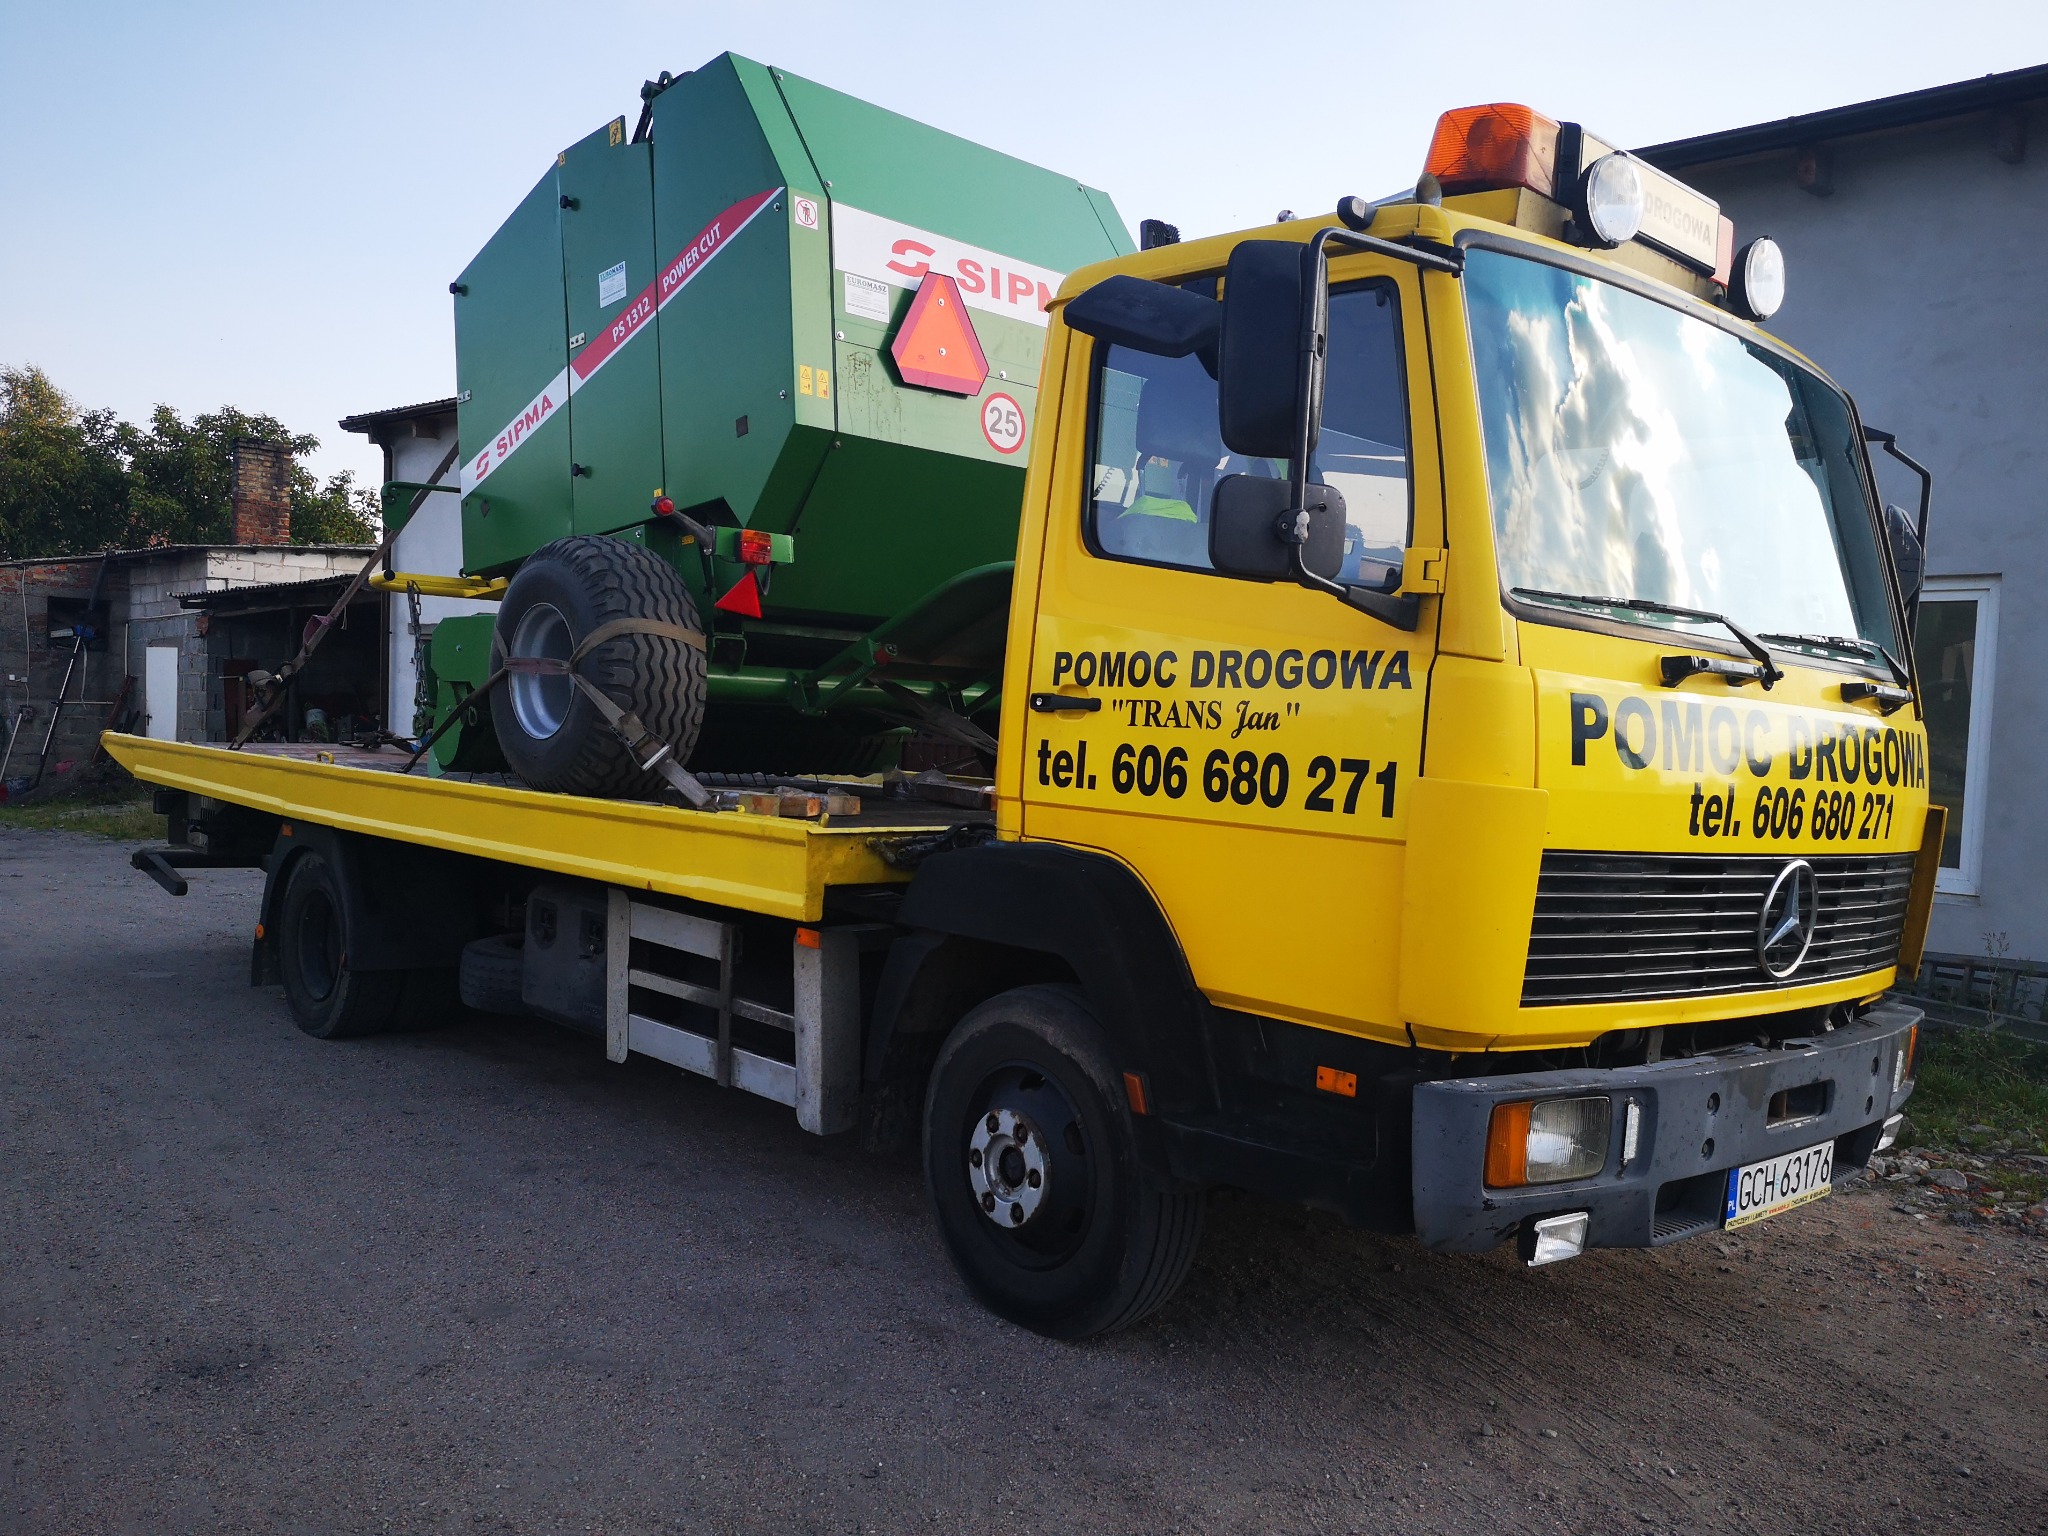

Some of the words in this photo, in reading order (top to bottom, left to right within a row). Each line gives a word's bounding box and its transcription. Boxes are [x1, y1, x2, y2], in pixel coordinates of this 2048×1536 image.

[1644, 191, 1711, 246] DROGOWA
[612, 320, 626, 342] PS
[626, 297, 651, 330] 1312
[662, 246, 700, 292] POWER
[700, 222, 723, 253] CUT
[496, 394, 553, 458] SIPMA
[989, 406, 1018, 438] 25
[1052, 650, 1177, 687] POMOC
[1190, 649, 1413, 690] DROGOWA
[1569, 692, 1772, 778] POMOC
[1789, 715, 1925, 789] DROGOWA
[1037, 738, 1097, 790] tel.
[1112, 743, 1189, 799] 606
[1202, 748, 1290, 809] 680
[1304, 755, 1398, 818] 271
[1689, 782, 1740, 838] tel.
[1752, 785, 1805, 840] 606
[1811, 789, 1856, 841] 680
[1858, 792, 1895, 840] 271
[1727, 1201, 1736, 1212] PL
[1739, 1162, 1777, 1211] GCH
[1780, 1145, 1832, 1198] 63176
